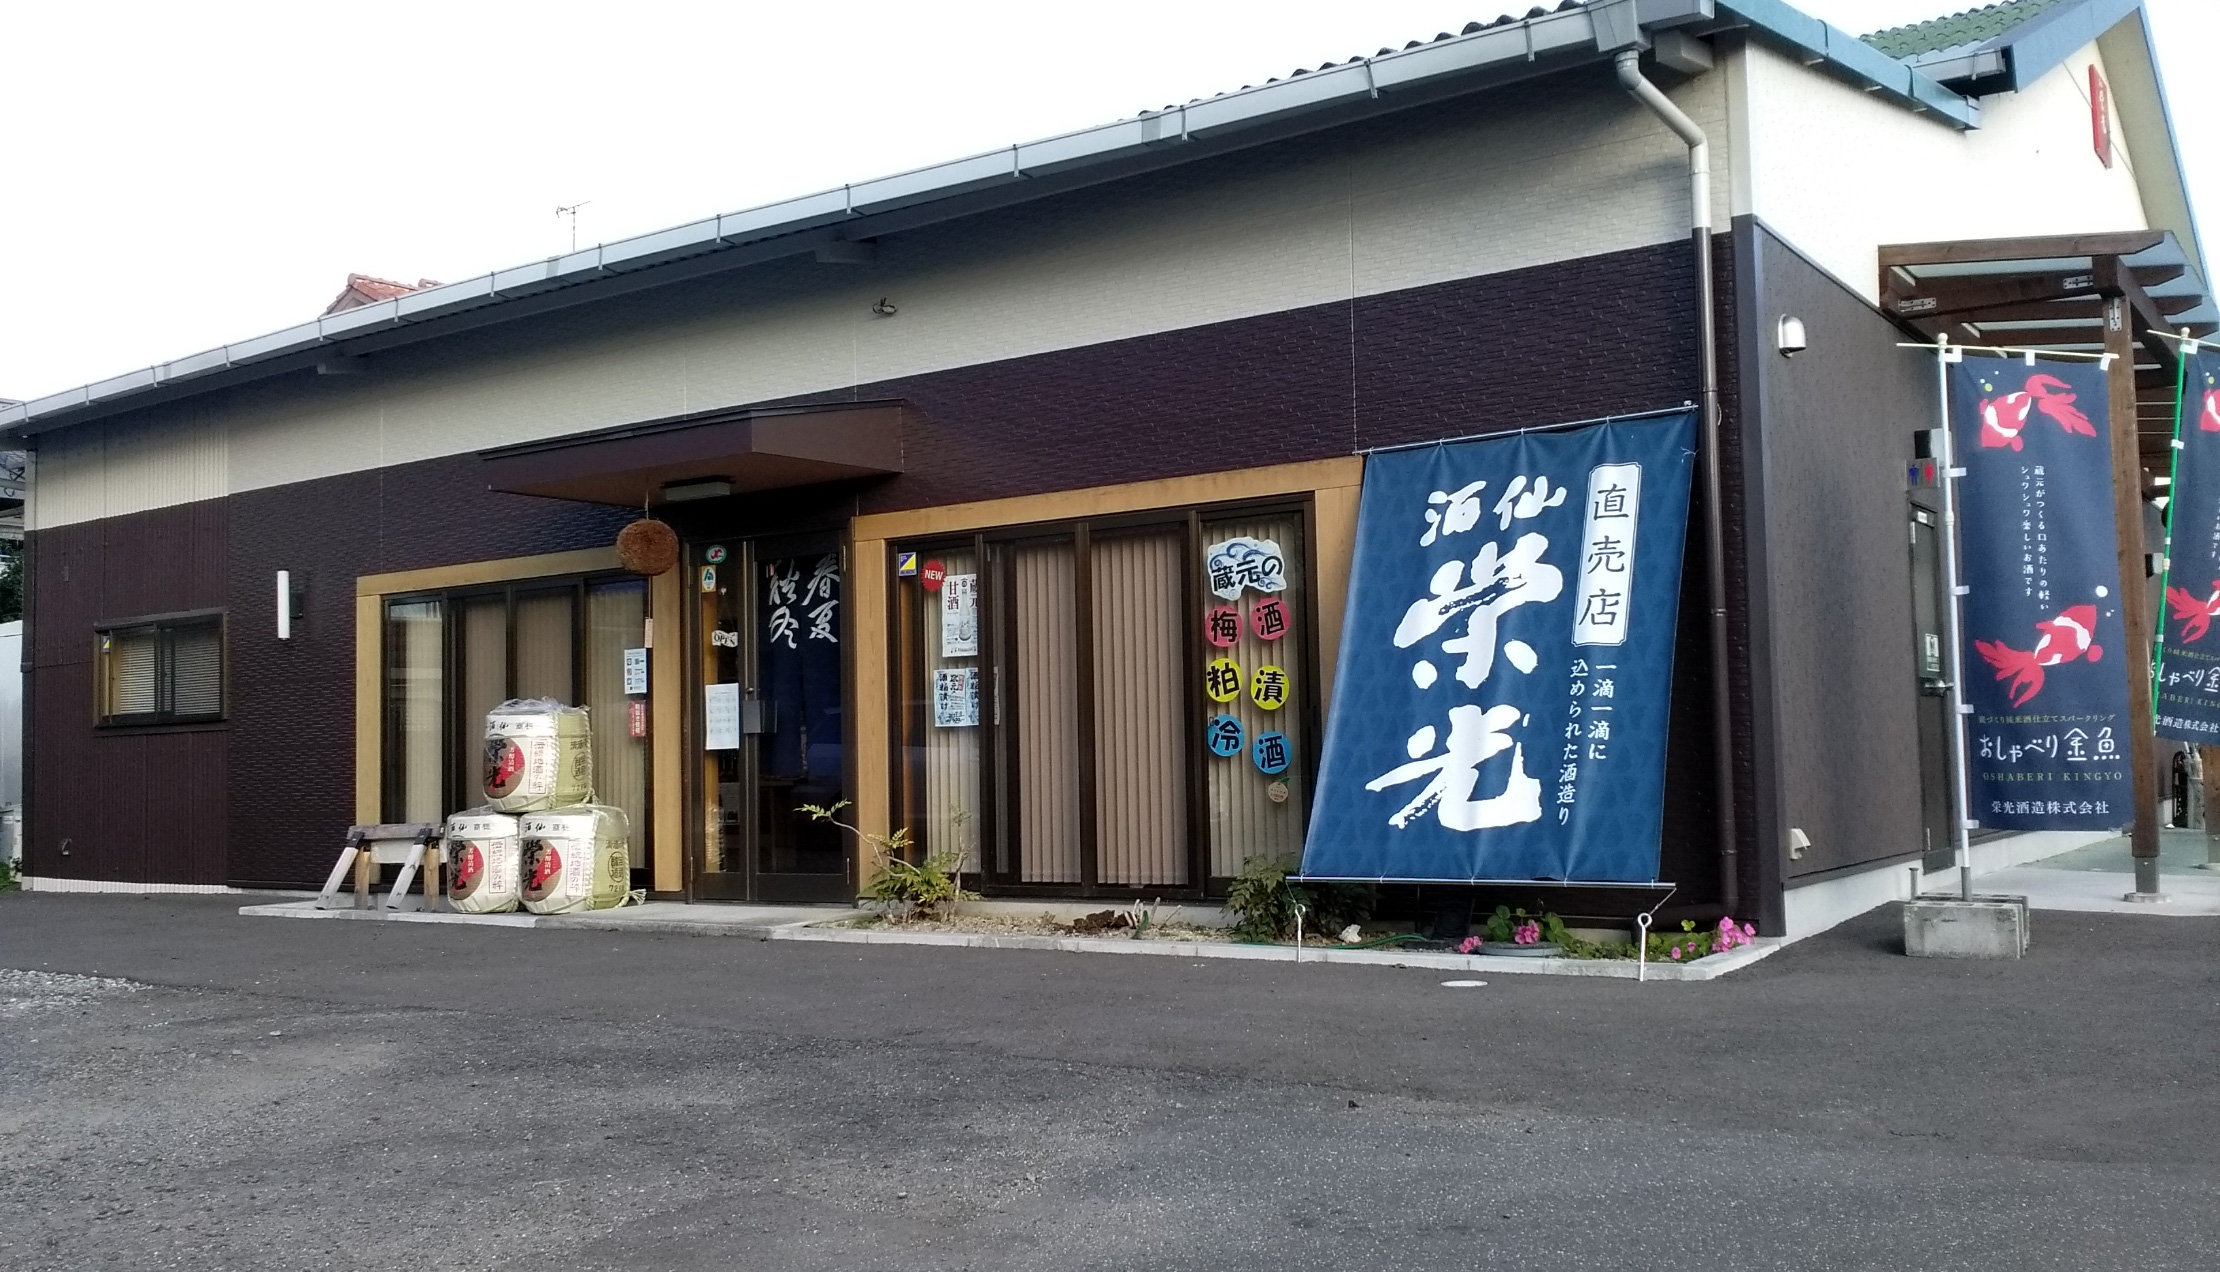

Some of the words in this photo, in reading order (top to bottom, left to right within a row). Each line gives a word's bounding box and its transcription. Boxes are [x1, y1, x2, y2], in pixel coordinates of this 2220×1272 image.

[1419, 475, 1567, 547] 酒仙
[2021, 465, 2034, 597] シュワシュワ楽しいお酒です
[1578, 483, 1630, 628] 直売店
[2034, 465, 2050, 610] 蔵元がつくる口あたりの軽い
[924, 569, 944, 581] NEW
[1211, 555, 1283, 592] 蔵元の
[801, 553, 840, 643] 春夏
[947, 580, 960, 611] 甘酒
[713, 634, 736, 647] OPEN
[1211, 601, 1285, 643] 梅酒
[1207, 662, 1286, 704] 粕漬
[1587, 663, 1617, 760] 一滴一滴に
[1212, 718, 1287, 770] 冷酒
[1556, 660, 1590, 826] 込められた酒造り
[1979, 726, 2121, 763] おしゃべり金魚
[1982, 772, 2053, 783] OSHABERI
[2063, 771, 2123, 782] KINGYO
[1991, 800, 2111, 815] 栄光酒造株式会社
